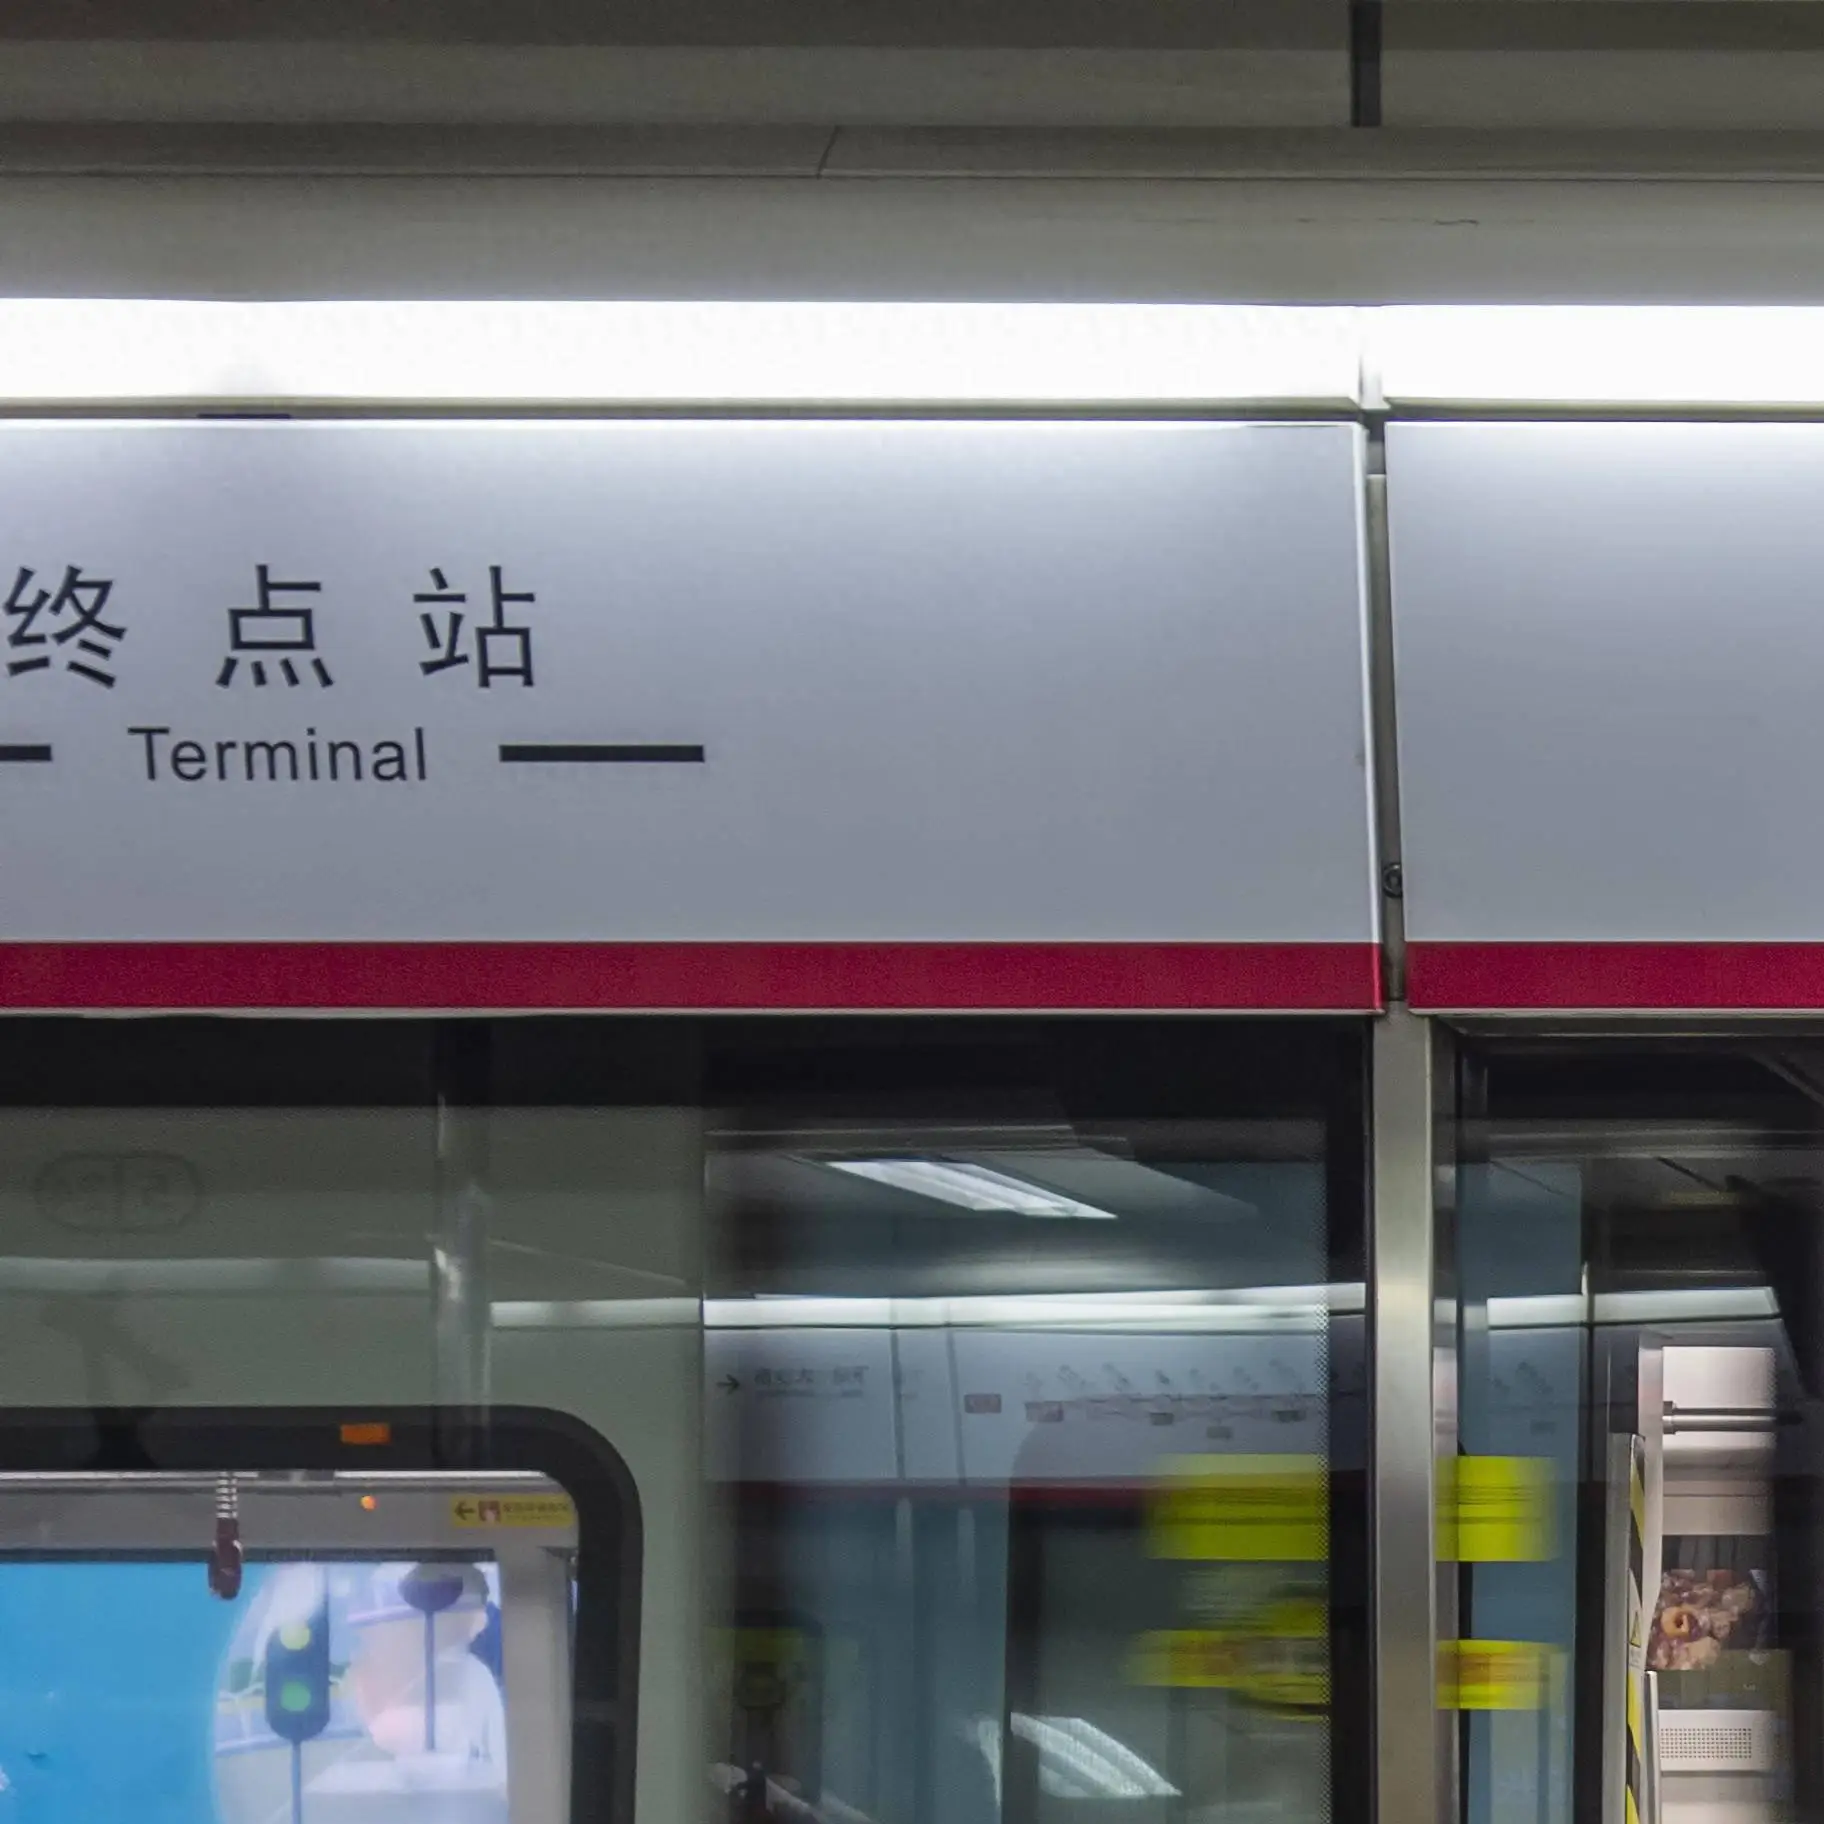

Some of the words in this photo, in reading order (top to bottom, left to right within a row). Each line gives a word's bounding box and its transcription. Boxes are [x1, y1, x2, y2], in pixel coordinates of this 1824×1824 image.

[4, 562, 537, 690] 终点站
[127, 727, 427, 782] Terminal
